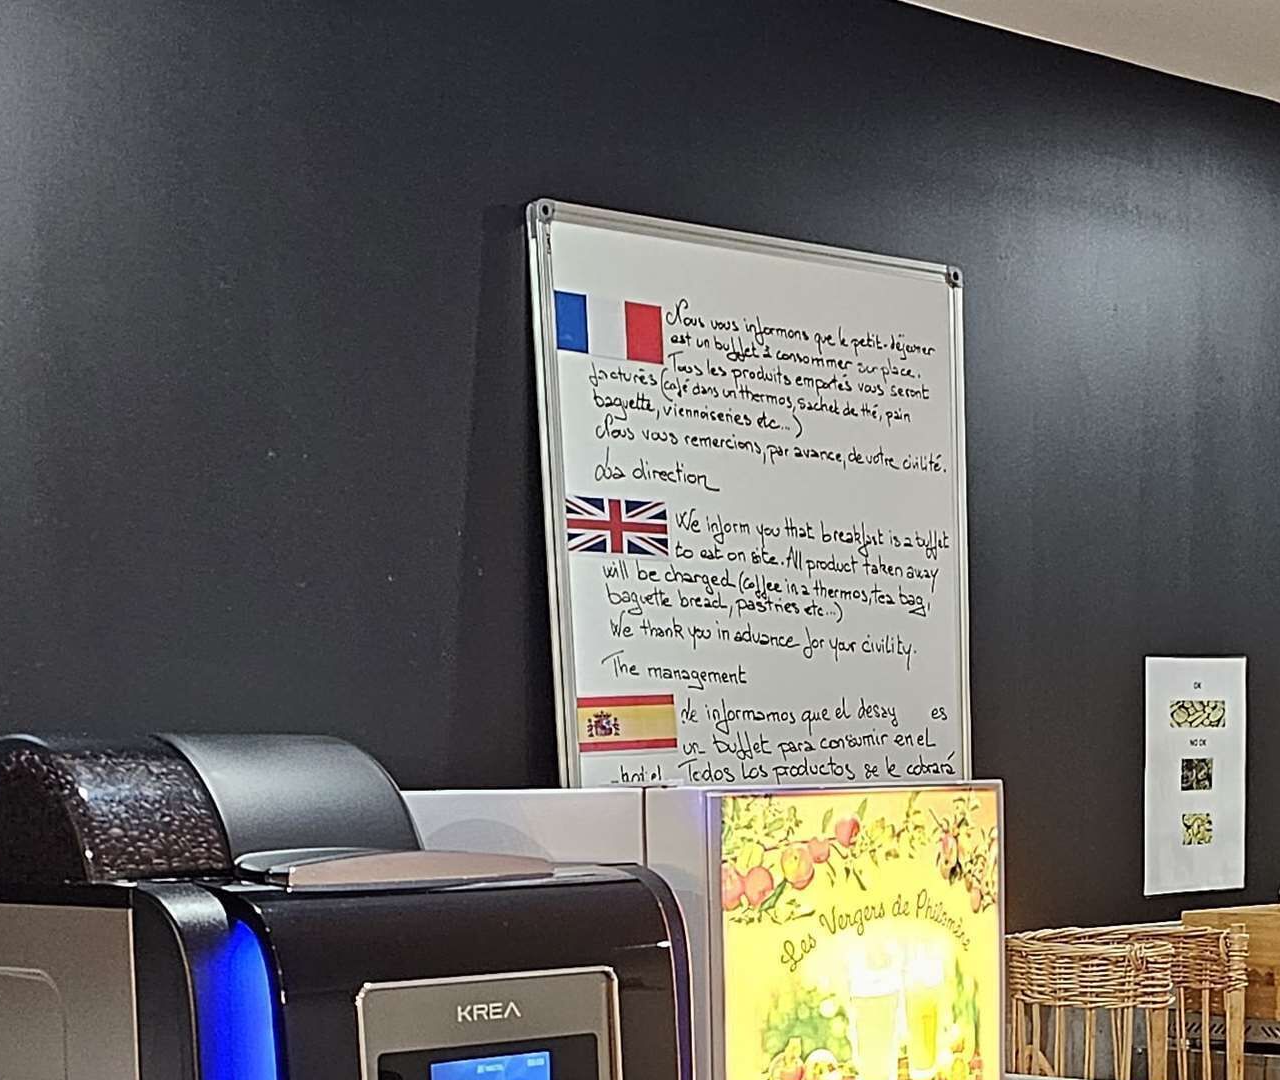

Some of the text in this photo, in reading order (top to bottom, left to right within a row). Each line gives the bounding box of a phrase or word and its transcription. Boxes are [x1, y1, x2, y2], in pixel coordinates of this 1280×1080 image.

[665, 298, 705, 328] Nous
[711, 319, 739, 331] vous
[743, 315, 810, 346] informons
[814, 332, 835, 354] que
[667, 351, 929, 400] Tous les produits emportés vous seront
[671, 332, 691, 347] est
[696, 338, 710, 348] un
[713, 335, 759, 362] buffet
[776, 349, 852, 369] consommer
[881, 357, 921, 384] place.
[588, 362, 658, 387] facturés
[692, 383, 719, 398] dans
[722, 388, 736, 399] un
[738, 383, 795, 412] thermos,
[843, 401, 858, 417] de
[861, 403, 883, 421] thé,
[885, 408, 911, 428] pain
[593, 388, 660, 421] baguette,
[595, 413, 635, 440] Nous
[642, 429, 679, 445] vous
[685, 433, 766, 464] remercions,
[766, 444, 789, 464] par
[794, 445, 847, 470] avance,
[848, 446, 862, 464] de
[866, 445, 900, 470] votre
[632, 458, 720, 491] direction
[675, 508, 949, 560] We inform you that breakfast is a buffet
[603, 559, 628, 580] will
[636, 559, 661, 582] be
[665, 564, 736, 595] charged
[785, 578, 796, 595] in
[800, 586, 810, 596] a
[813, 579, 872, 606] thermos,
[871, 584, 895, 605] tea
[675, 541, 939, 594] to eat on site. All product taken away
[605, 583, 672, 615] baguette
[678, 589, 733, 619] bread,
[735, 597, 799, 618] pastries
[610, 610, 917, 671] We thank you in advance for your civility.
[601, 650, 747, 690] The management
[705, 698, 796, 735] informamos
[801, 707, 831, 736] que
[835, 697, 851, 719] el
[931, 707, 948, 720] es
[678, 758, 735, 783] Todos
[772, 756, 855, 785] productos
[864, 762, 878, 779] se
[885, 755, 901, 778] le
[906, 751, 956, 776] cobrará
[683, 741, 706, 756] un
[712, 731, 772, 761] buffet
[777, 740, 816, 761] para
[820, 728, 888, 749] consumir
[893, 734, 913, 747] en
[780, 933, 817, 973] Les
[819, 902, 886, 936] Vergers
[891, 893, 911, 917] de
[457, 1001, 522, 1022] KREA
